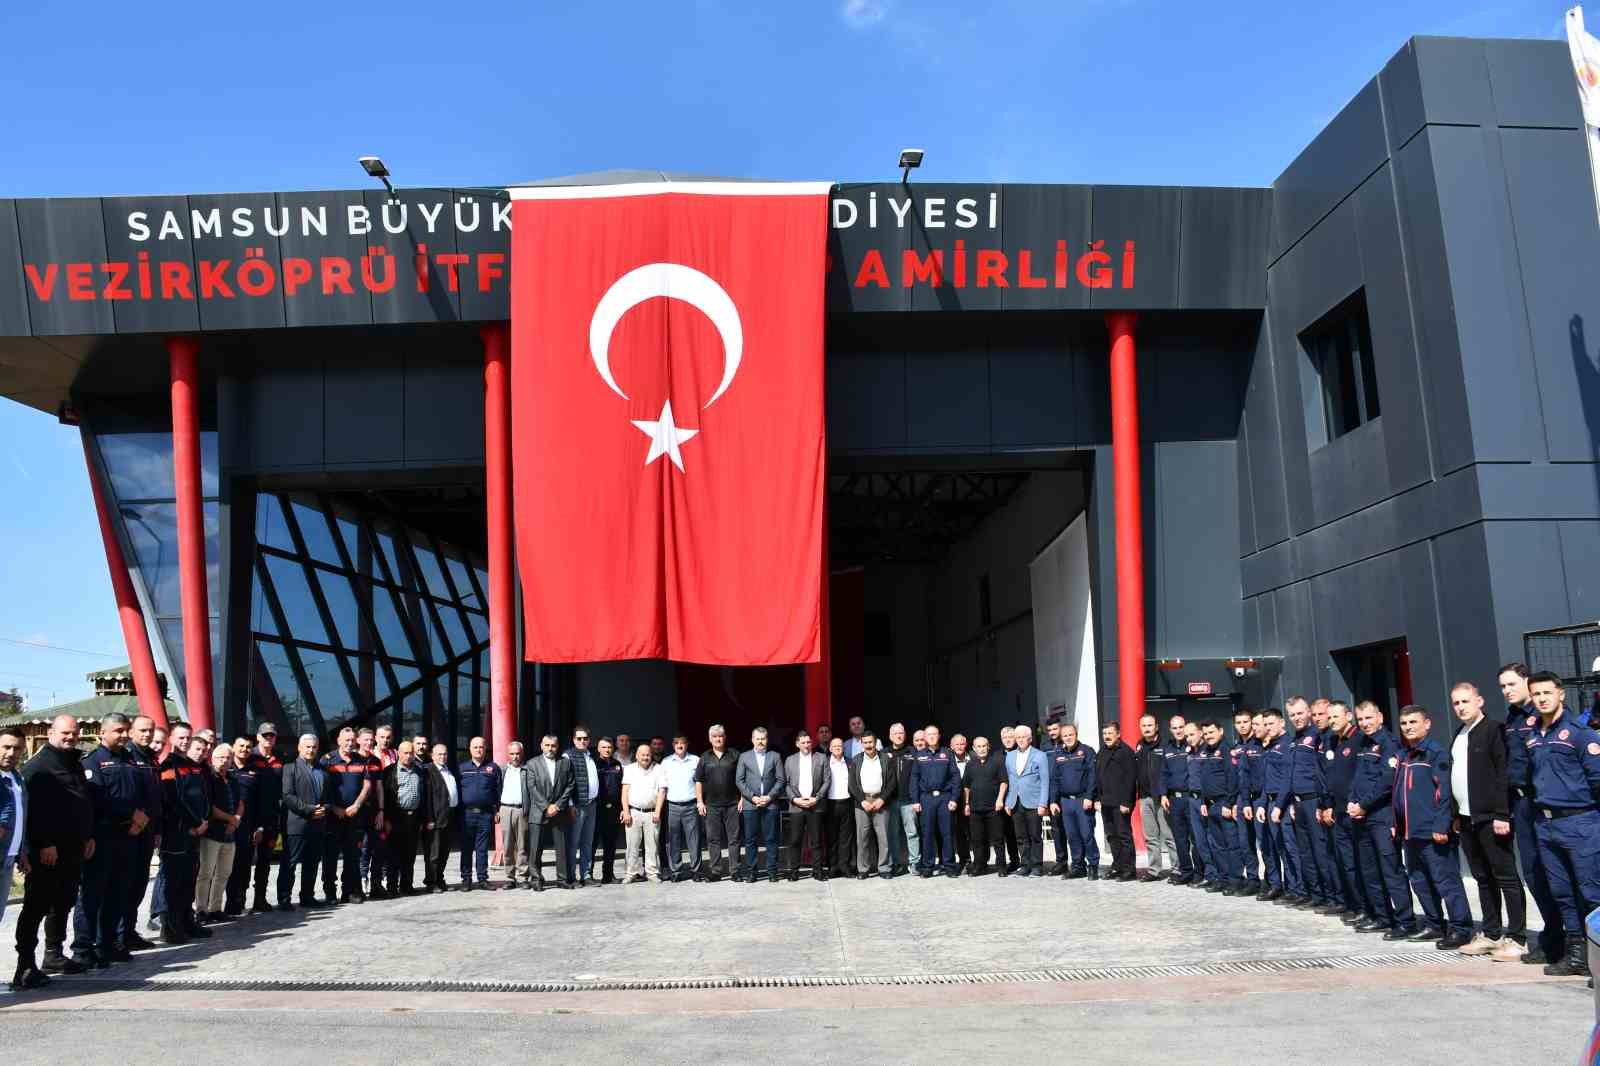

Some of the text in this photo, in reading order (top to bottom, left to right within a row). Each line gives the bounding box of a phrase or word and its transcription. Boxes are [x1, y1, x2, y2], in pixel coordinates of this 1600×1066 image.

[127, 206, 329, 242] SAMSUN
[24, 246, 397, 302] VEZİRKÖPRÜ
[854, 239, 1136, 289] AMİRLİĞİ
